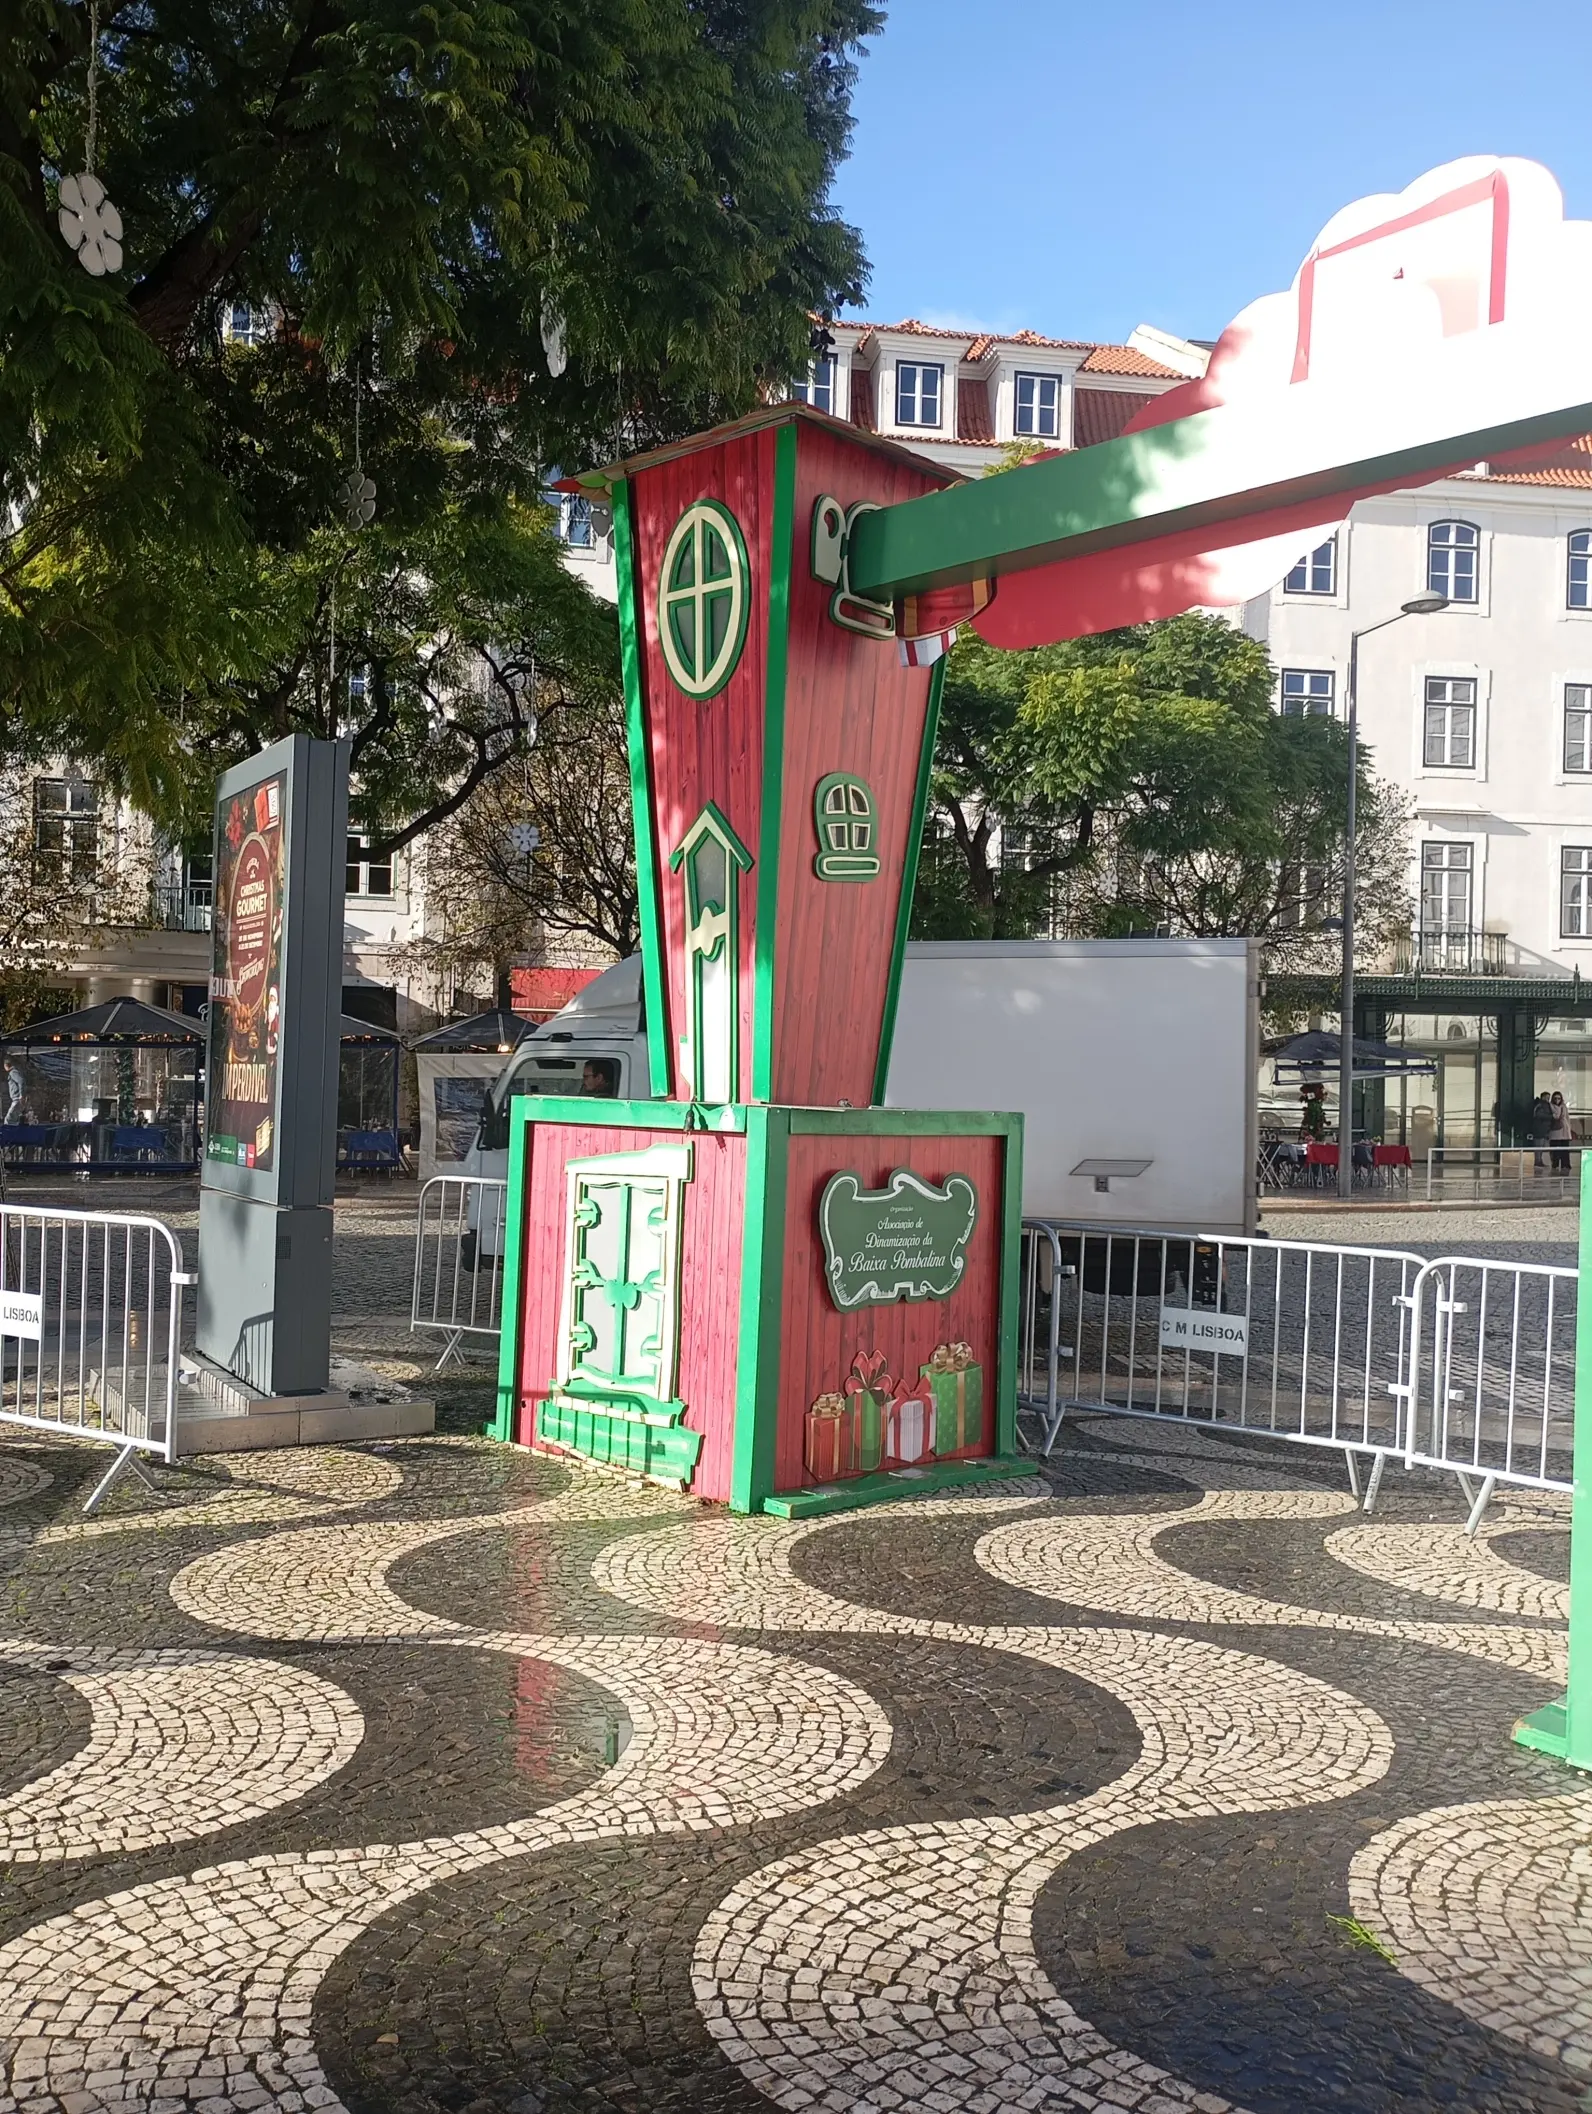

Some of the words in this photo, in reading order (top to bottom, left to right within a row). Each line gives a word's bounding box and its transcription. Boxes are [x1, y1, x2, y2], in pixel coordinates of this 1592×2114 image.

[241, 880, 265, 896] CHRISTMAS
[236, 893, 267, 917] GOURMET
[222, 1054, 268, 1103] IMPERDÍVEL
[878, 1216, 914, 1230] Associação
[915, 1216, 924, 1228] de
[865, 1232, 920, 1249] Dinamização
[923, 1232, 933, 1246] da
[849, 1252, 887, 1272] Baixa
[891, 1249, 946, 1270] Pombalina
[4, 1307, 39, 1324] LISBOA
[1162, 1320, 1171, 1332] C
[1175, 1322, 1187, 1334] M
[1193, 1324, 1245, 1342] LISBOA
